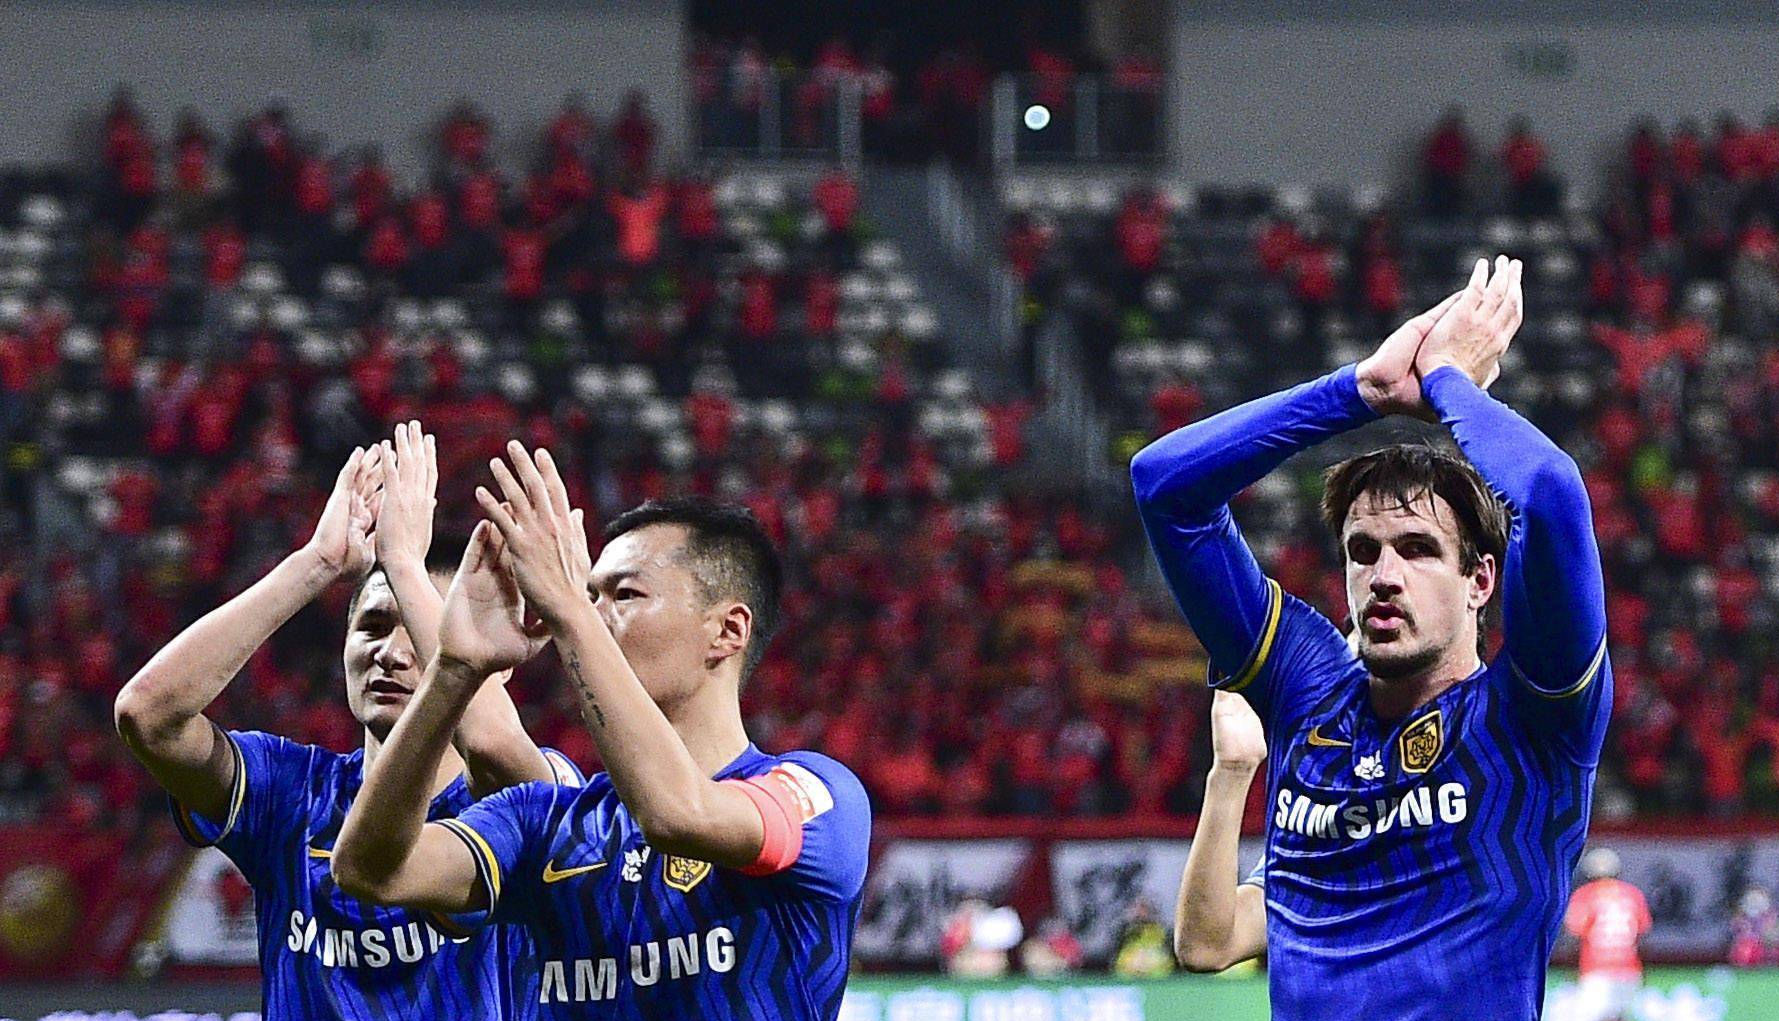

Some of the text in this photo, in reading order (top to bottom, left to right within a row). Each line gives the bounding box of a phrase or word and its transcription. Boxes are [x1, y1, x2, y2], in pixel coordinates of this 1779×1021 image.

[1275, 783, 1467, 840] SAMSUNG
[287, 910, 470, 968] SAMSUN
[539, 926, 736, 1004] AMUNG
